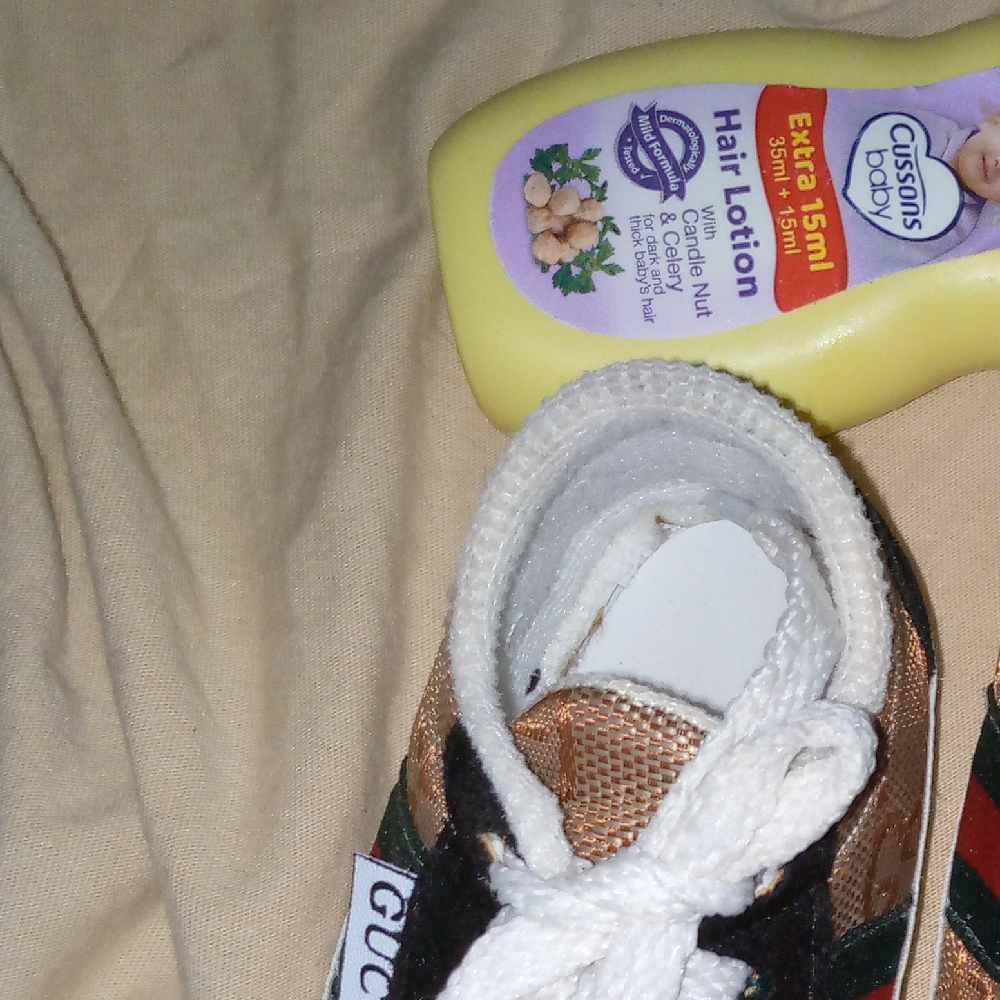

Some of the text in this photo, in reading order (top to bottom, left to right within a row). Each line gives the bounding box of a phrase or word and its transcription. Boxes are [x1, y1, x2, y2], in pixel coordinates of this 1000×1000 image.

[623, 147, 641, 174] Tested
[637, 114, 680, 191] Mild Formula
[660, 114, 700, 173] Dermatologically
[865, 149, 894, 220] baby
[890, 123, 922, 230] Cussons
[701, 205, 717, 240] With
[713, 108, 760, 298] Hair Lotion
[769, 136, 802, 255] 35ml + 15ml
[788, 112, 835, 272] Extra 15ml
[630, 215, 657, 323] thick baby's hair
[643, 213, 666, 295] for dark and
[660, 212, 683, 292] & Celery
[682, 209, 713, 318] Candle Nut
